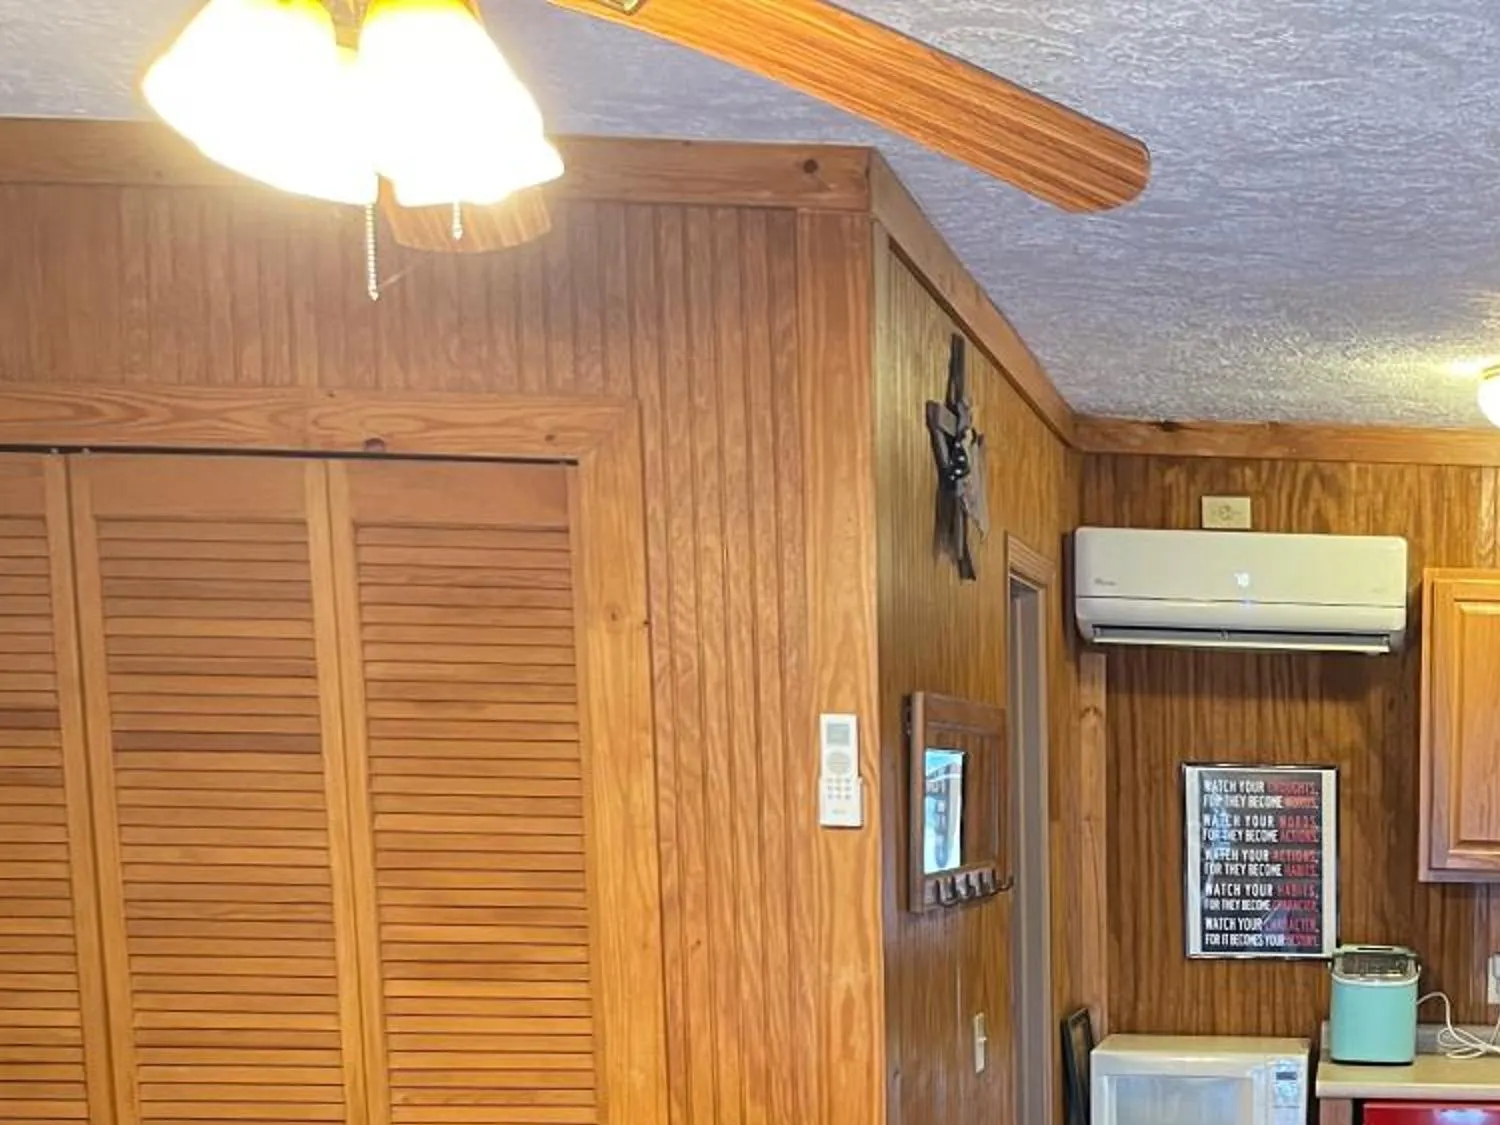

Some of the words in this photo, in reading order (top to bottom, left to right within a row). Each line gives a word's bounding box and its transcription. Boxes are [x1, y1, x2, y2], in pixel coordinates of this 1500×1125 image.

[1239, 780, 1265, 793] YOUR
[1244, 814, 1275, 827] YOUR
[1245, 829, 1280, 843] BECOME
[1241, 849, 1270, 862] YOUR
[1225, 863, 1247, 876] THEY
[1248, 863, 1283, 877] BECOME
[1205, 883, 1241, 897] WATCH
[1244, 883, 1274, 897] YOUR
[1205, 917, 1237, 931] WATCH
[1237, 917, 1263, 931] YOUR
[1205, 933, 1220, 945] FOR
[1221, 933, 1229, 946] IT
